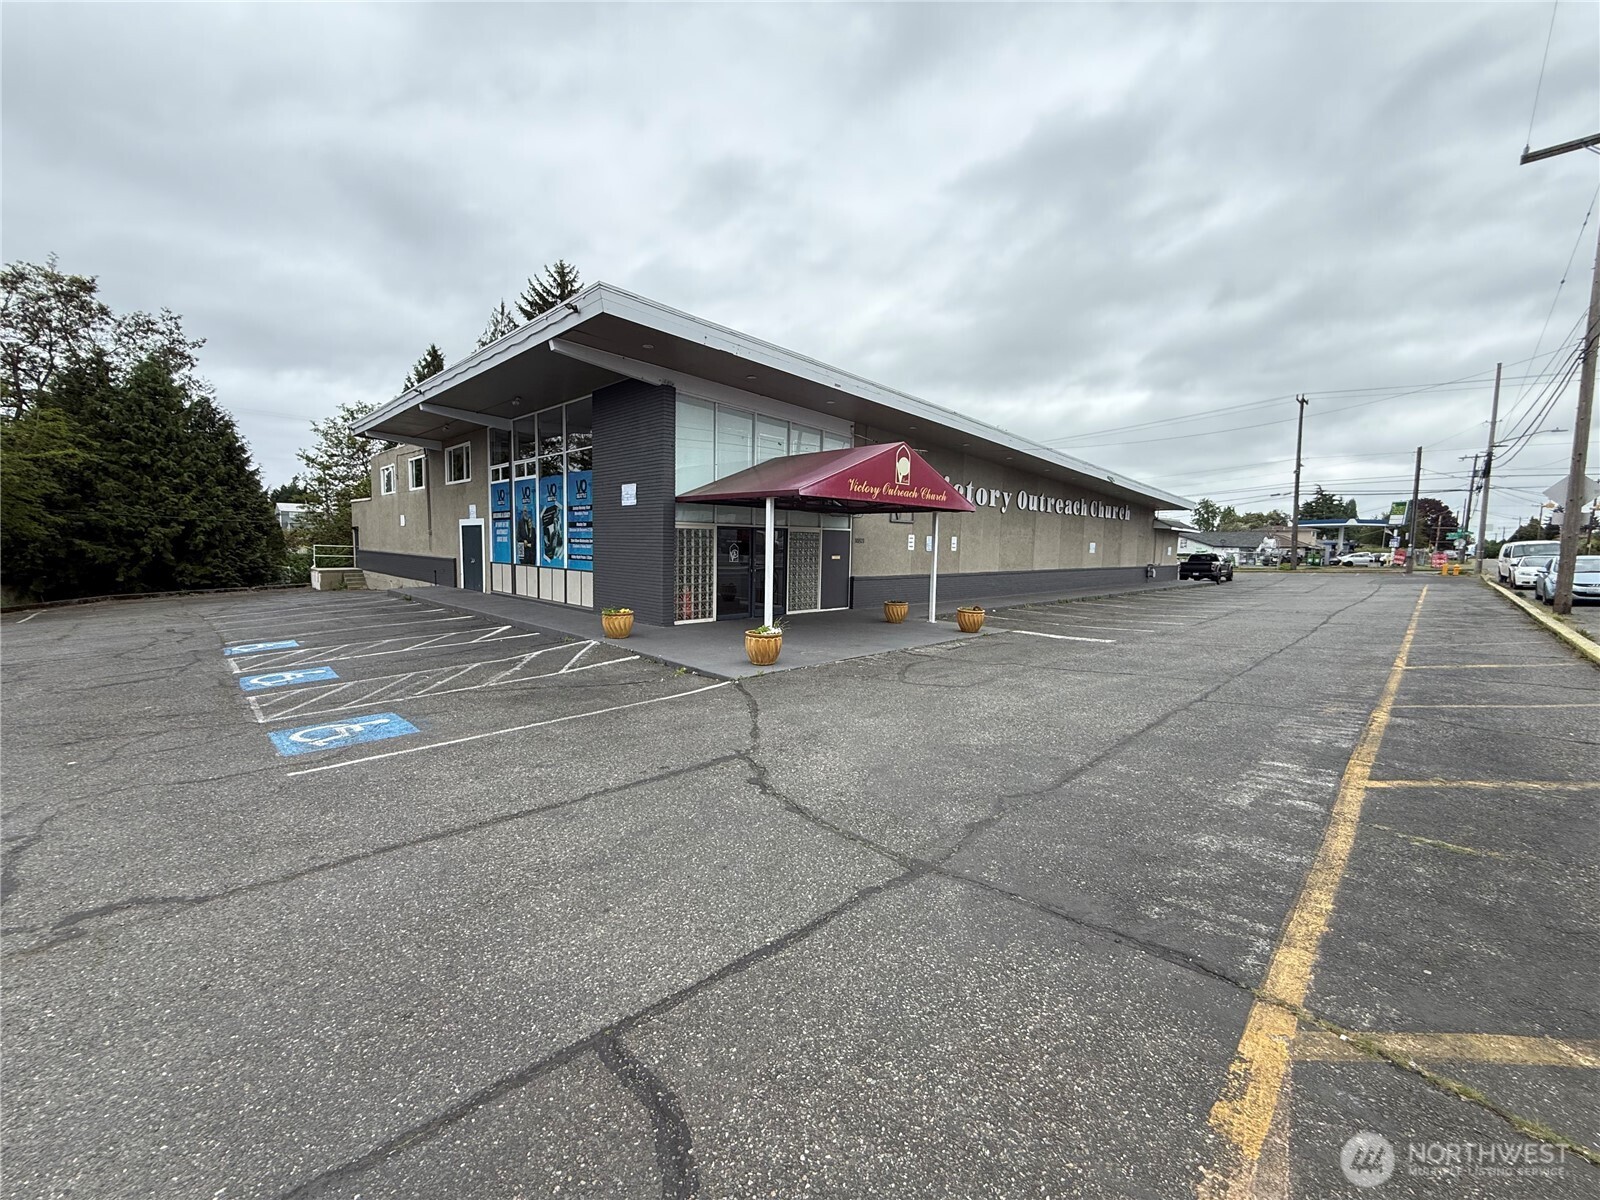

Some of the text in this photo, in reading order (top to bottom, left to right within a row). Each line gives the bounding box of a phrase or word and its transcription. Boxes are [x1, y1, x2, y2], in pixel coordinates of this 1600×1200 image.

[847, 478, 947, 502] Victory Outreach Church
[943, 476, 1131, 521] ctory Outreach Church
